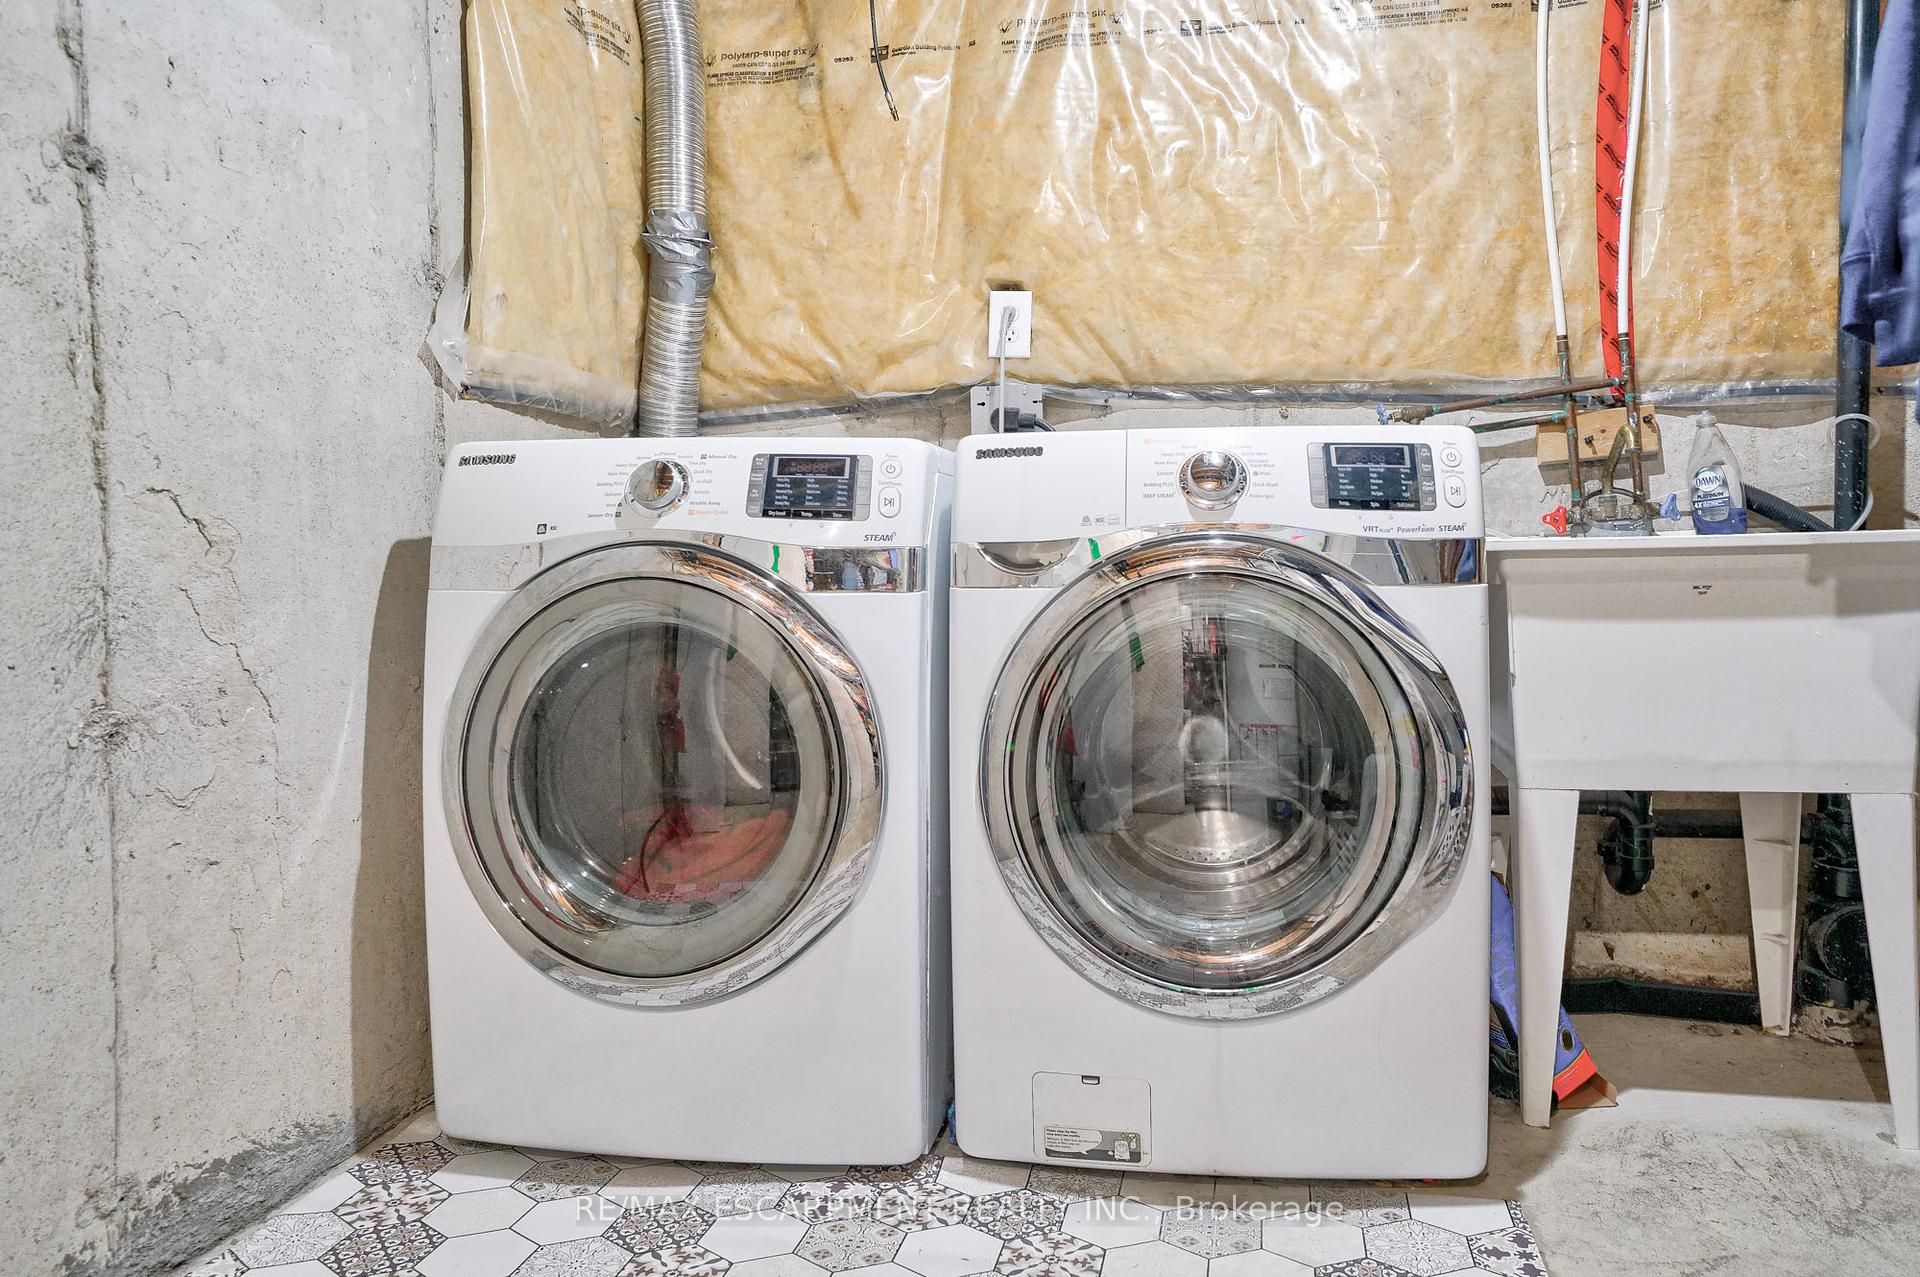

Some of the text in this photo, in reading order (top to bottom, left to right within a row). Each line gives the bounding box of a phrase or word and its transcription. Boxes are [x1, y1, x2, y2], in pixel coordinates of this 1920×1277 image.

[1091, 8, 1107, 18] six
[793, 46, 808, 56] six
[975, 446, 1043, 460] SAMSUNG
[458, 454, 517, 467] SAMSUNG
[1695, 475, 1721, 487] DAWN
[1396, 524, 1435, 533] PowerFoam
[1438, 523, 1466, 532] STEAM
[864, 533, 895, 542] STEAM
